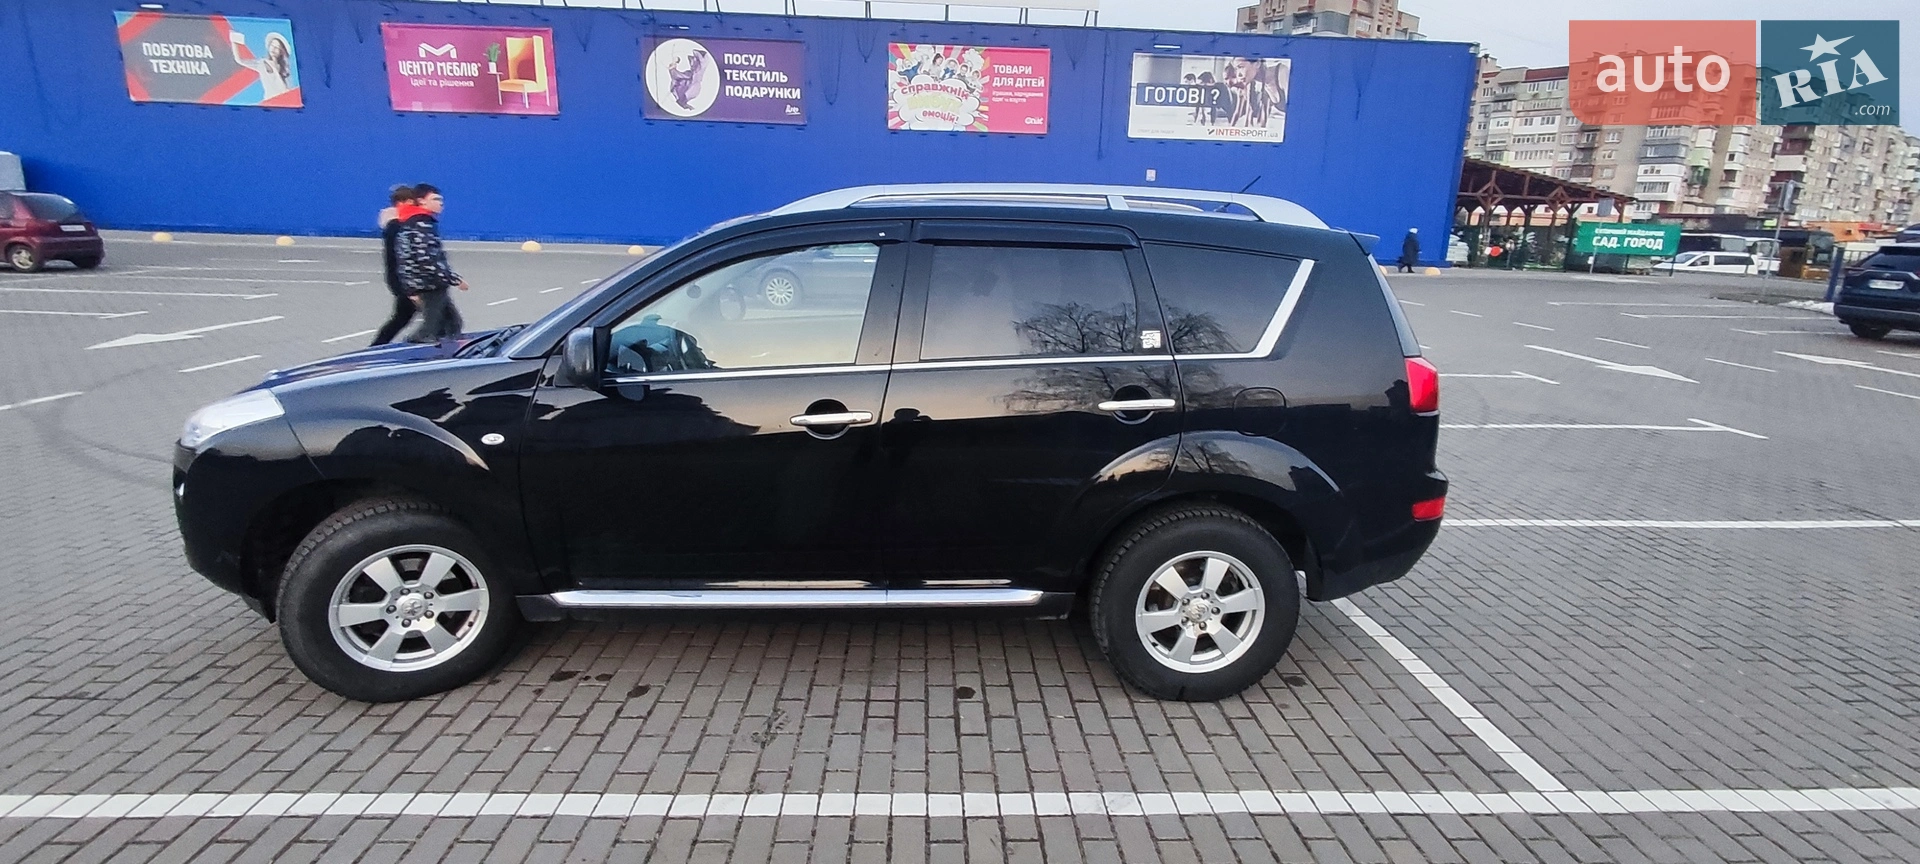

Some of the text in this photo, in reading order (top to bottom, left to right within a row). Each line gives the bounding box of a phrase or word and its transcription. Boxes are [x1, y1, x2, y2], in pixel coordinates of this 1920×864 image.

[142, 42, 214, 59] ПОБУТОВА
[724, 53, 766, 67] ПОСУД
[150, 59, 211, 76] ТЕХНІКА
[398, 61, 479, 77] ЦЕНТР МЕБЛІВ
[993, 64, 1032, 75] ТОВАРИ
[427, 79, 438, 87] та
[724, 69, 788, 83] ТЕКСТИЛЬ
[992, 76, 1045, 88] ДЛЯ ДІТЕЙ
[725, 85, 801, 100] ПОДАРУНКИ
[1144, 86, 1221, 105] ГОТОВІ ?
[1592, 236, 1664, 250] САД. ГОРОД
